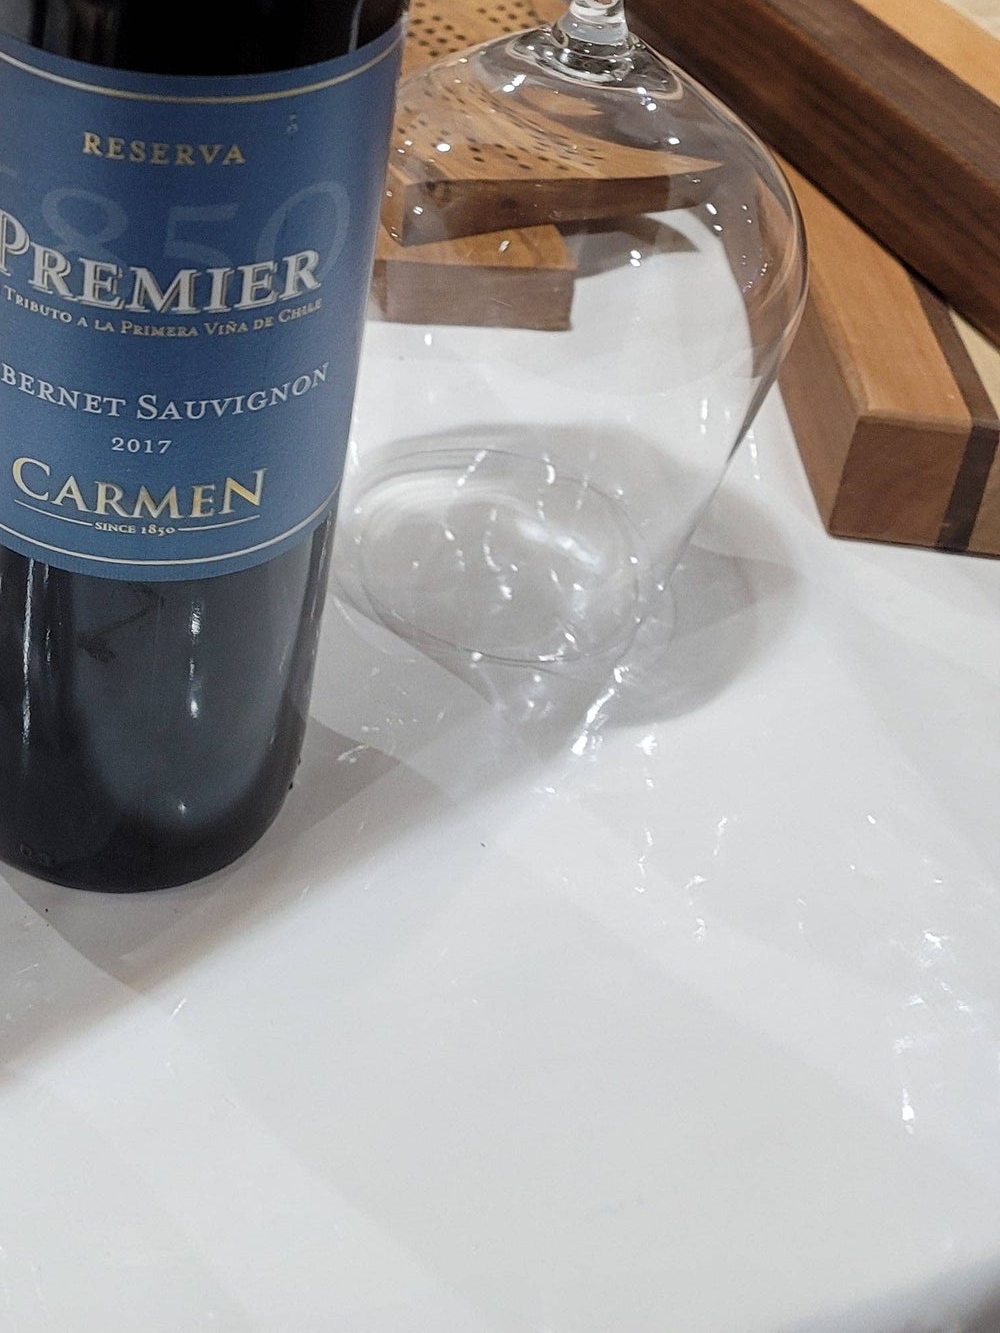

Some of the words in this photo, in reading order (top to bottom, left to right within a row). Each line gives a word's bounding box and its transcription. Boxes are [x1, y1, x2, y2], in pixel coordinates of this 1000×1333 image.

[82, 131, 246, 166] RESERVA
[3, 284, 72, 323] TRIBUTO
[77, 316, 88, 328] A
[94, 319, 115, 333] LA
[121, 320, 199, 338] PRIMERA
[203, 320, 249, 336] VIÑA
[253, 316, 274, 331] DE
[278, 298, 323, 323] CHILE
[136, 361, 330, 421] SAUVIGNON
[111, 436, 173, 454] 2017
[11, 455, 269, 520] CARMEN
[94, 521, 136, 534] SINCE
[141, 524, 177, 537] 1850
